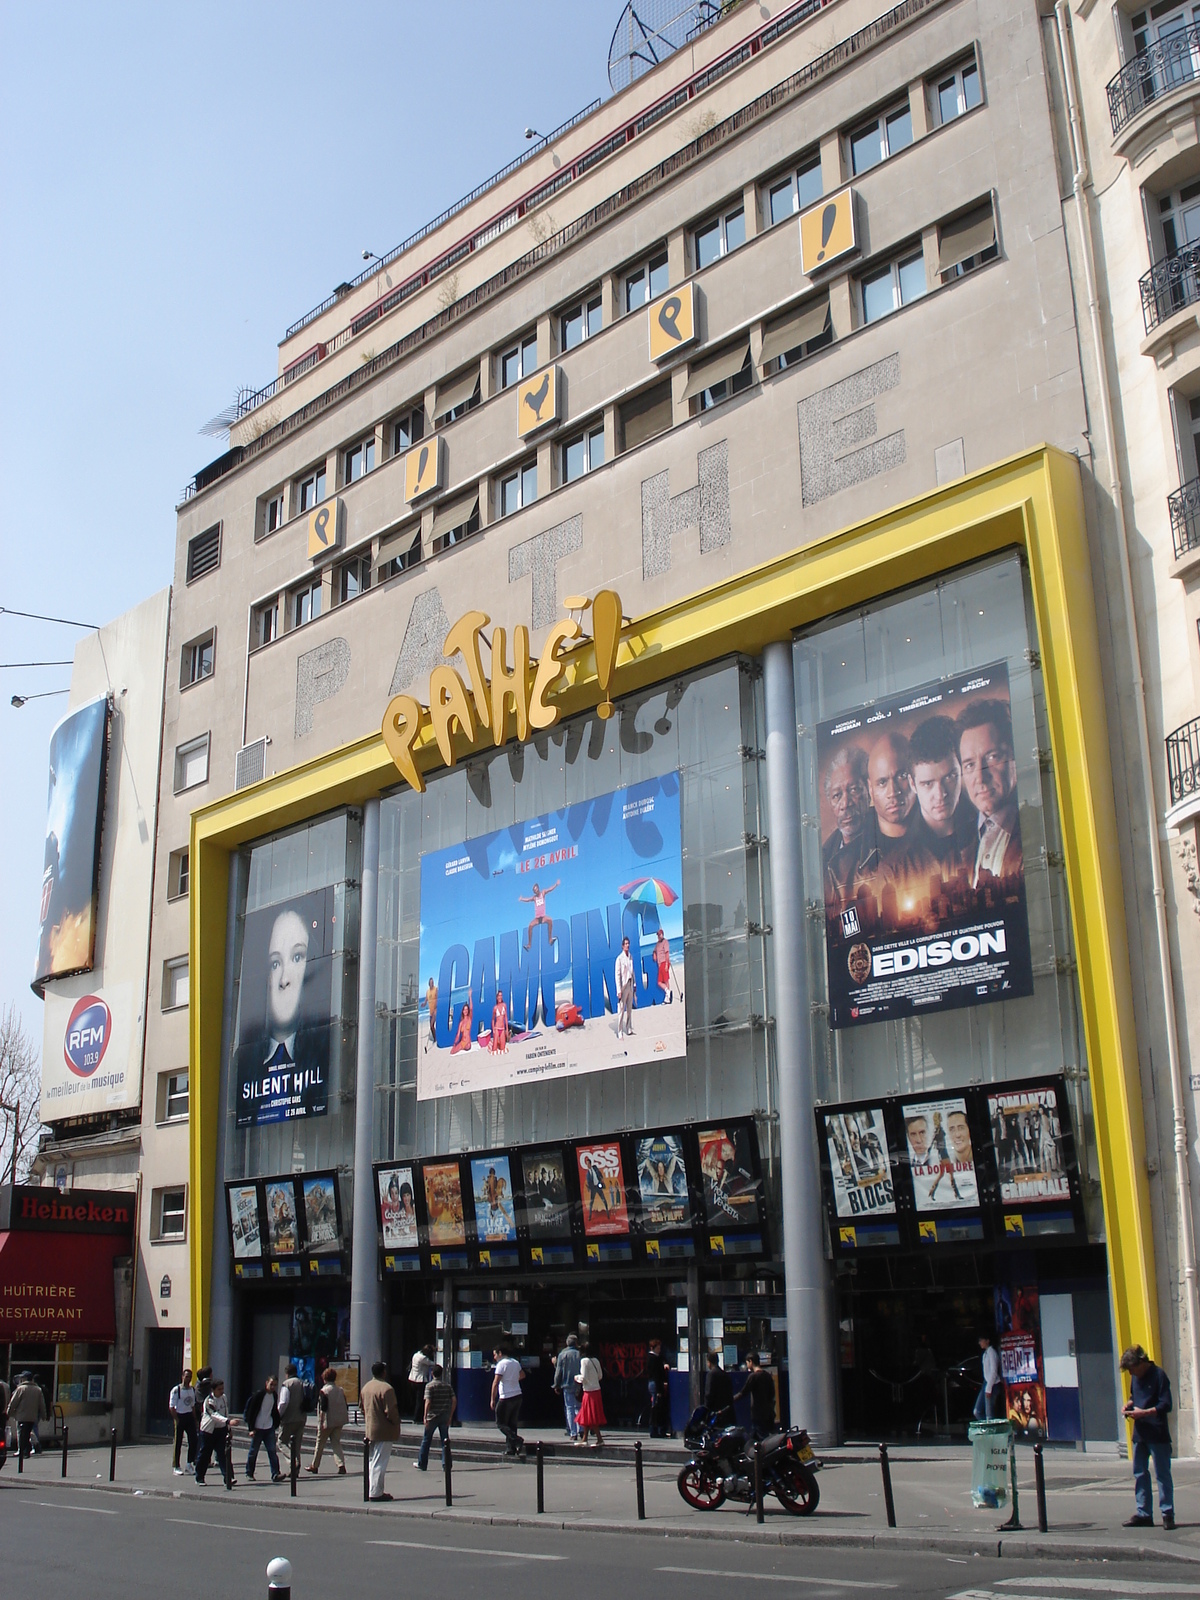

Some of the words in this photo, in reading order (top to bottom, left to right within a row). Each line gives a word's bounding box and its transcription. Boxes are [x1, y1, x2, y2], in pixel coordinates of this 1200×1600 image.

[961, 679, 991, 693] SPACEY
[967, 677, 984, 686] KEVIN
[899, 695, 942, 713] TIMBERLAKE
[867, 714, 886, 724] COOL
[831, 721, 861, 736] FREEMAN
[520, 861, 530, 874] LE
[534, 857, 546, 870] 26
[549, 846, 576, 865] AVRIL
[843, 910, 855, 924] 10
[844, 920, 859, 936] MAI
[872, 944, 884, 953] DANS
[898, 939, 909, 948] VILLE
[916, 932, 943, 943] CORRUPTION
[943, 930, 952, 938] EST
[984, 919, 1005, 929] POUVOIR
[872, 929, 1007, 977] EDISON
[436, 899, 666, 1049] CAMPING
[69, 1025, 104, 1051] RFM
[83, 1051, 99, 1066] 103.9
[46, 1090, 51, 1099] le
[51, 1081, 81, 1097] meilleur
[80, 1083, 86, 1091] de
[86, 1082, 91, 1090] la
[91, 1072, 125, 1089] musique
[242, 1074, 291, 1100] SILENT
[293, 1066, 324, 1094] HILL
[285, 1109, 290, 1117] LE
[988, 1090, 1058, 1119] ROMANZO
[579, 1149, 619, 1170] OSS
[603, 1167, 620, 1178] 117
[914, 1165, 925, 1177] LA
[848, 1179, 894, 1214] BLOCS
[1001, 1177, 1069, 1200] CRIMINALE
[21, 1197, 129, 1223] Heineken
[4, 1283, 76, 1298] HUÎTRIÈRE
[0, 1307, 83, 1319] RESTAURANT
[15, 1330, 67, 1341] WEPLER
